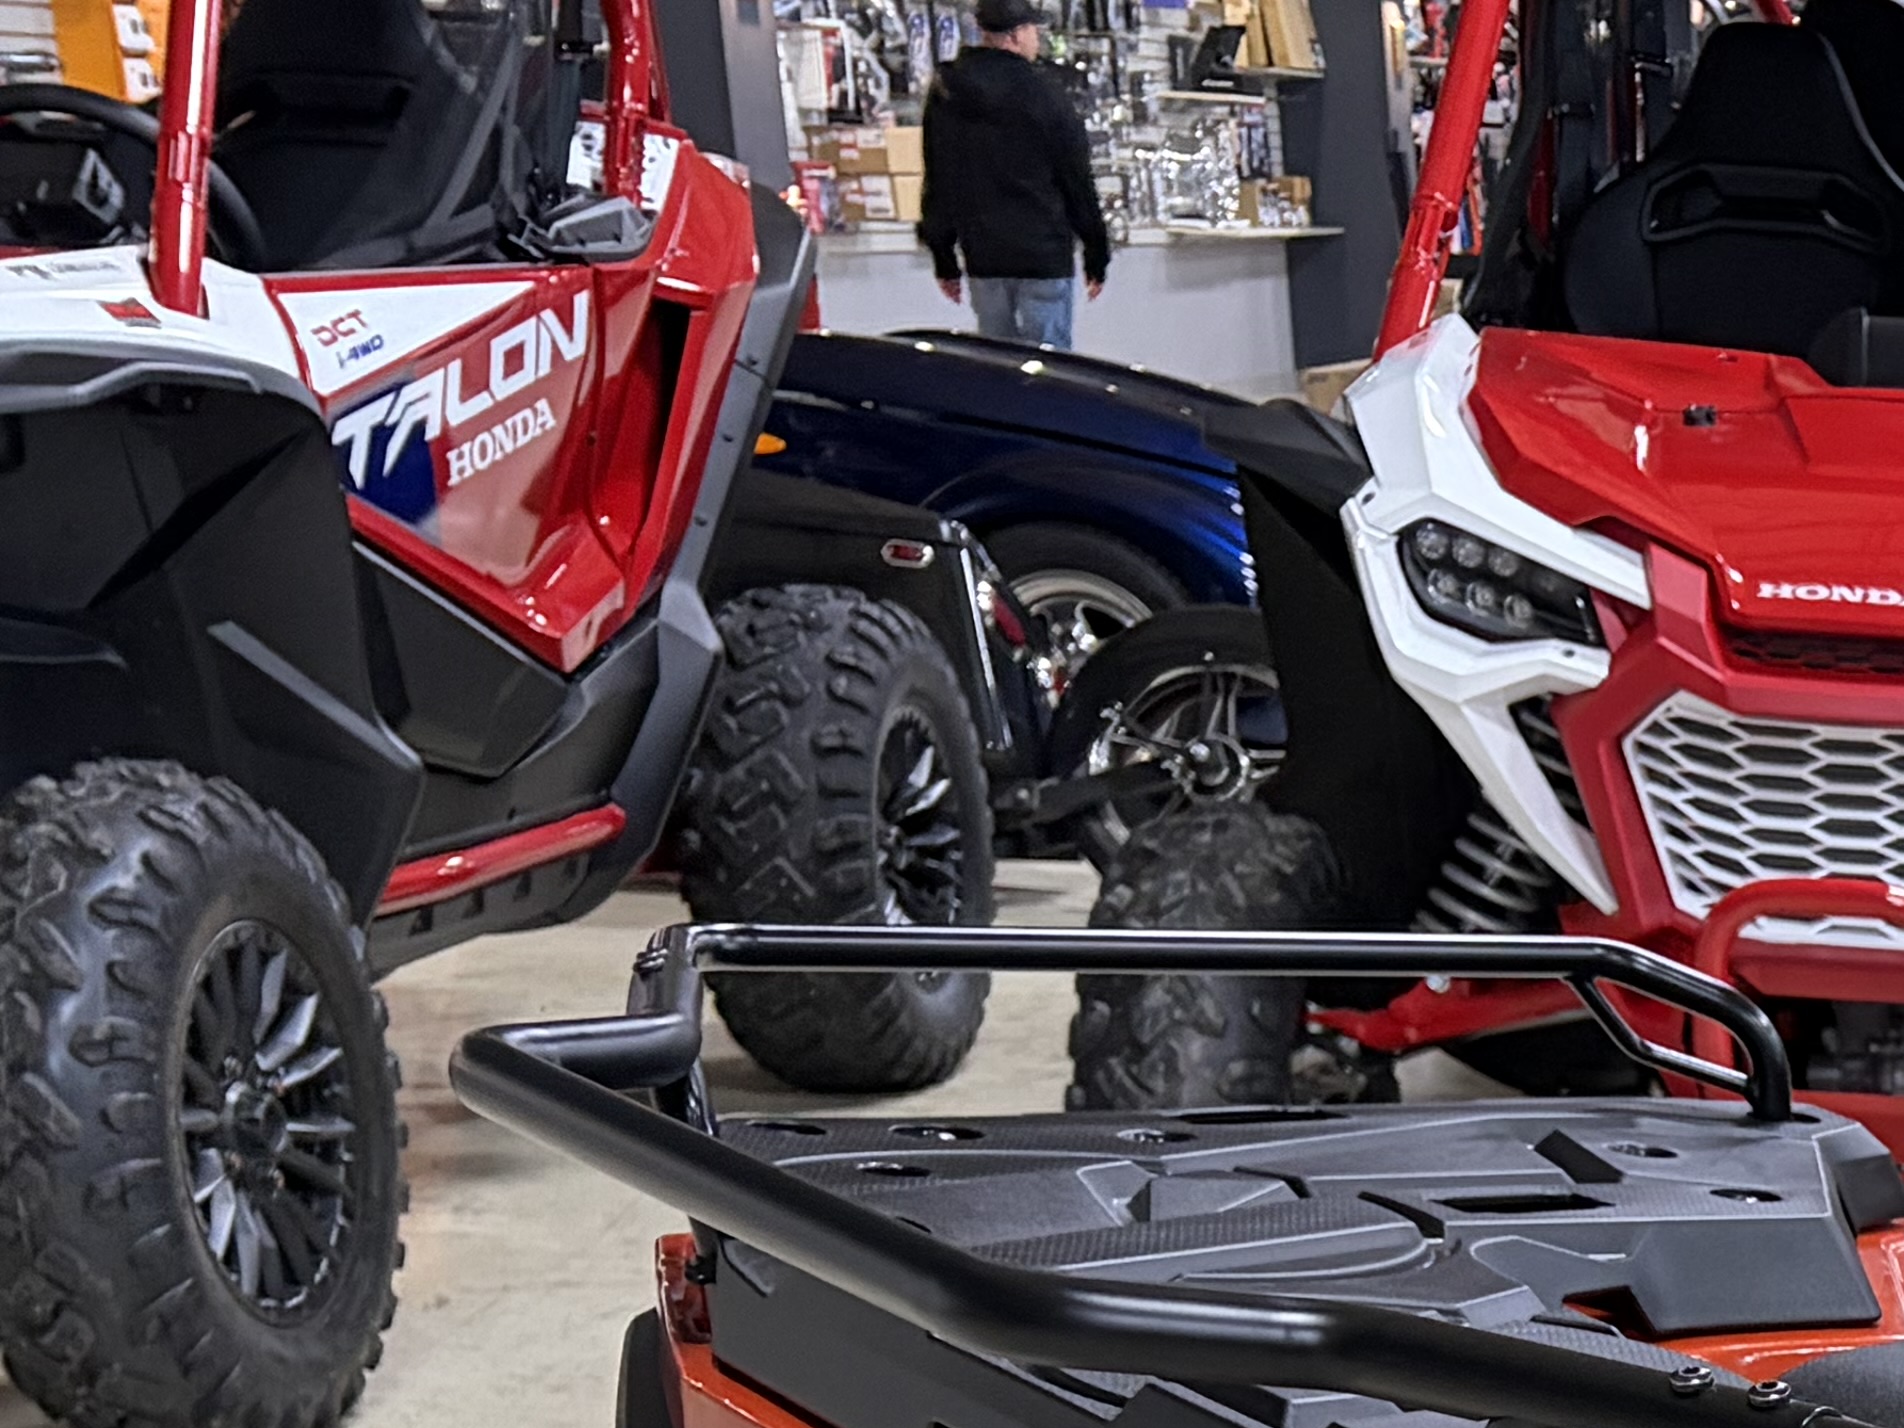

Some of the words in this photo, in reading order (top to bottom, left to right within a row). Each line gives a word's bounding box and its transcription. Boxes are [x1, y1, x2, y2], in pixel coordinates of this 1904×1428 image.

[310, 308, 368, 347] DCT
[331, 289, 590, 490] TALON
[446, 397, 556, 487] HONDA
